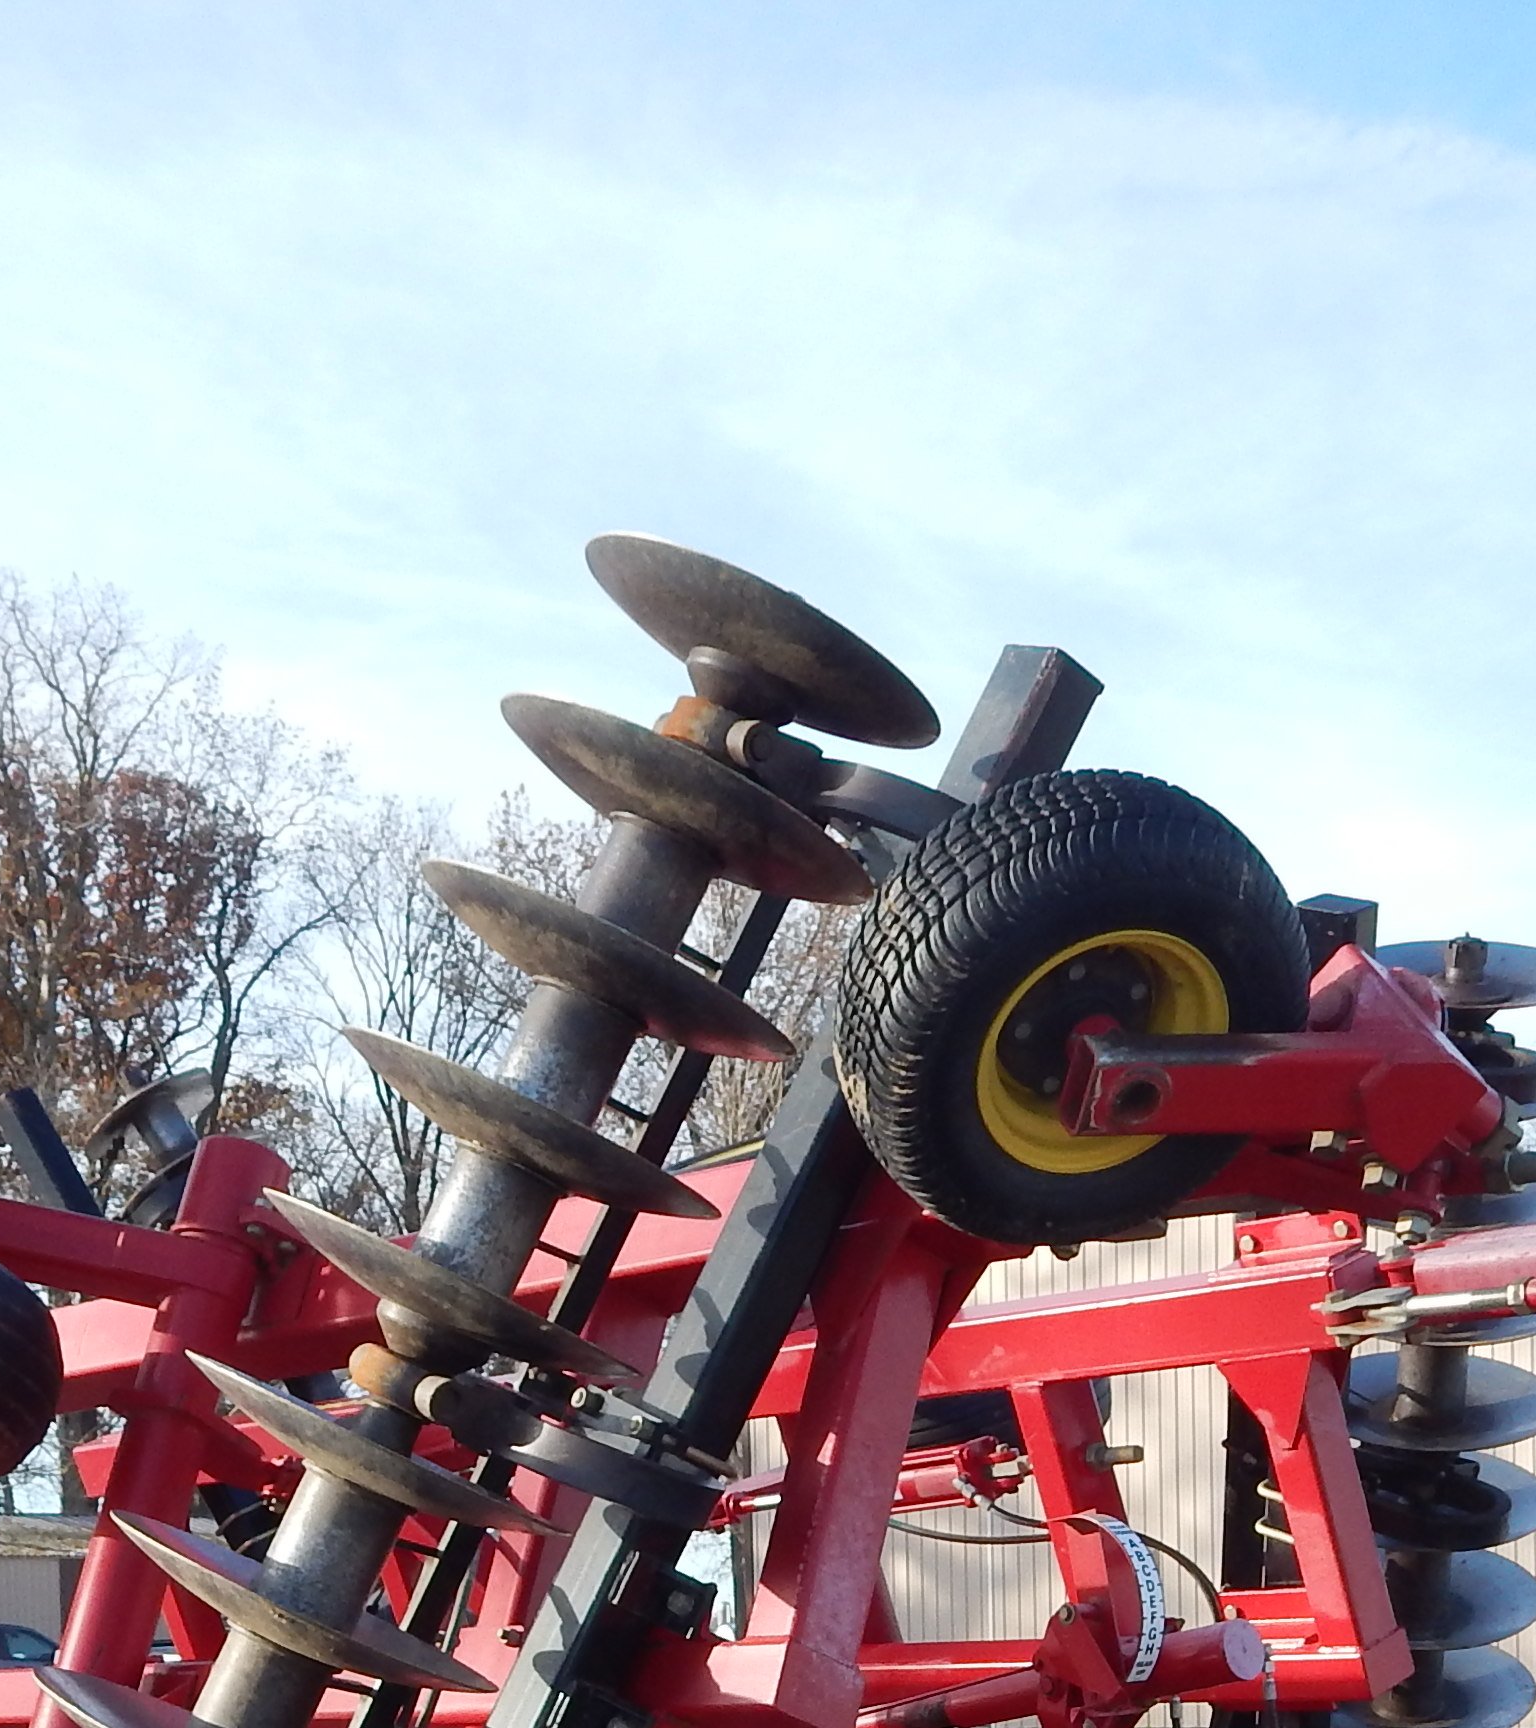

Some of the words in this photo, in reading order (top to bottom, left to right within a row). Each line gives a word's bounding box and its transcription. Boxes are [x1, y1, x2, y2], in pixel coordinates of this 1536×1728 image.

[1129, 1538, 1139, 1549] A
[1135, 1551, 1146, 1562] B
[1142, 1564, 1152, 1577] C
[1146, 1579, 1155, 1593] D
[1149, 1595, 1157, 1609] E
[1150, 1611, 1158, 1625] F
[1148, 1627, 1157, 1641] G
[1144, 1643, 1155, 1656] H
